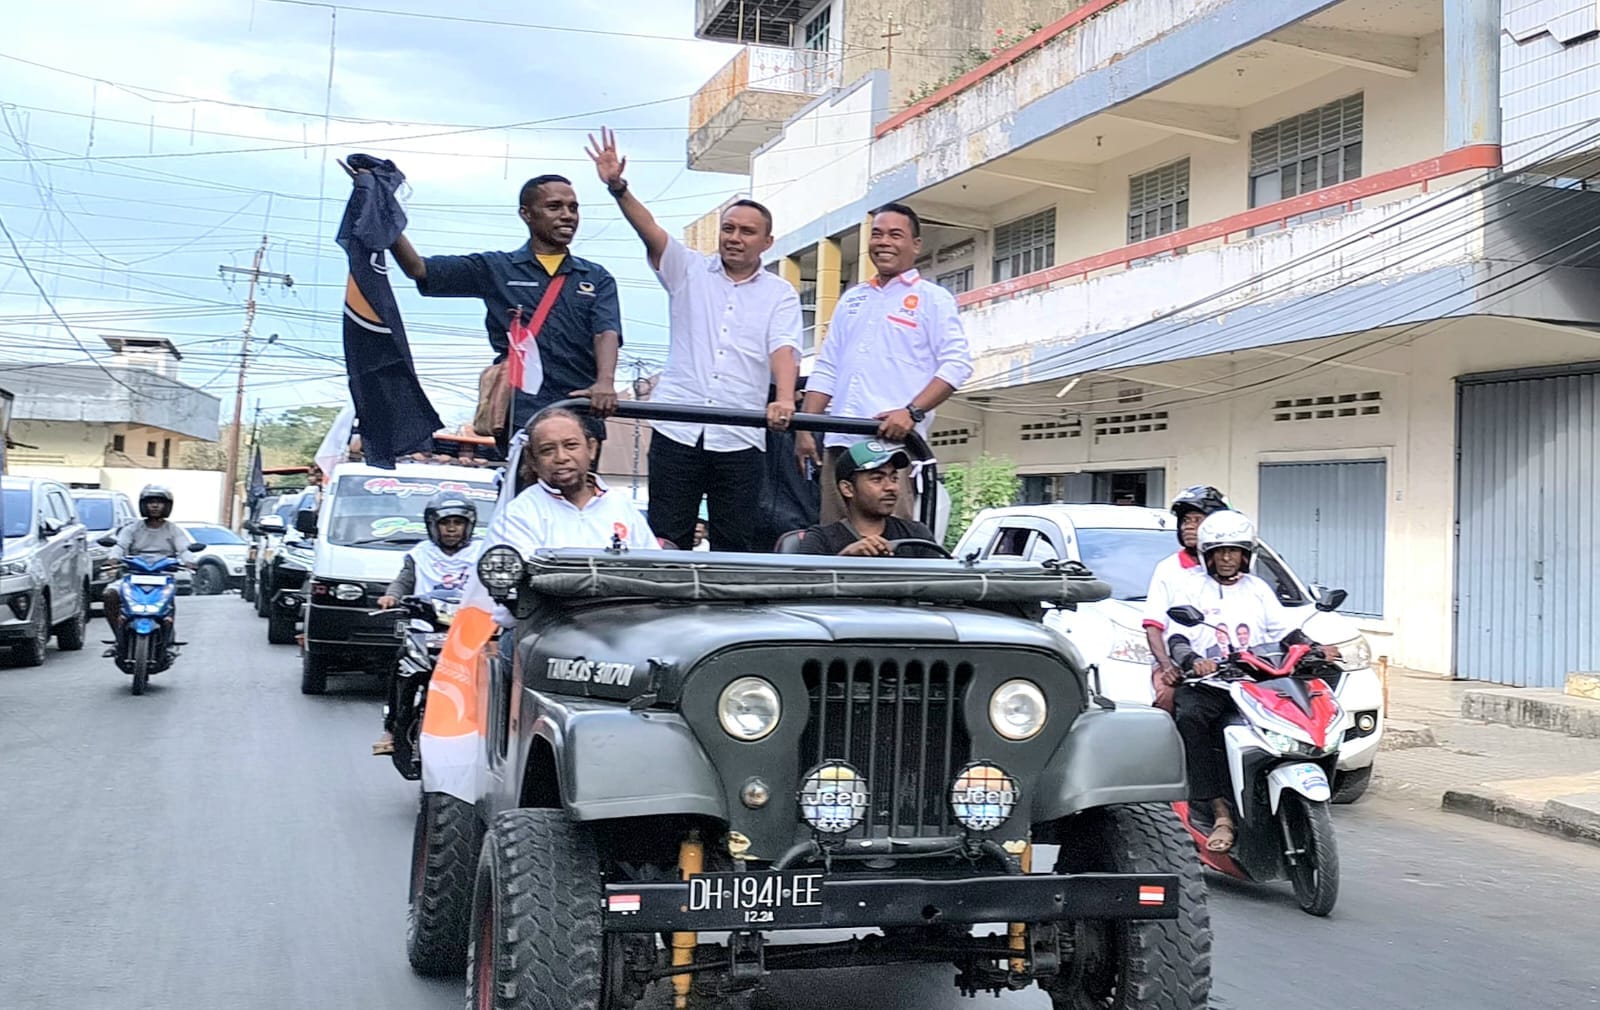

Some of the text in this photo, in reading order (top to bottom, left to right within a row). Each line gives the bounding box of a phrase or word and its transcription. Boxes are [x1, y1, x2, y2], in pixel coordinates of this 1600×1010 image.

[807, 787, 866, 808] Jeep
[957, 786, 1015, 808] Jeep
[689, 874, 824, 911] DH 1941 EE
